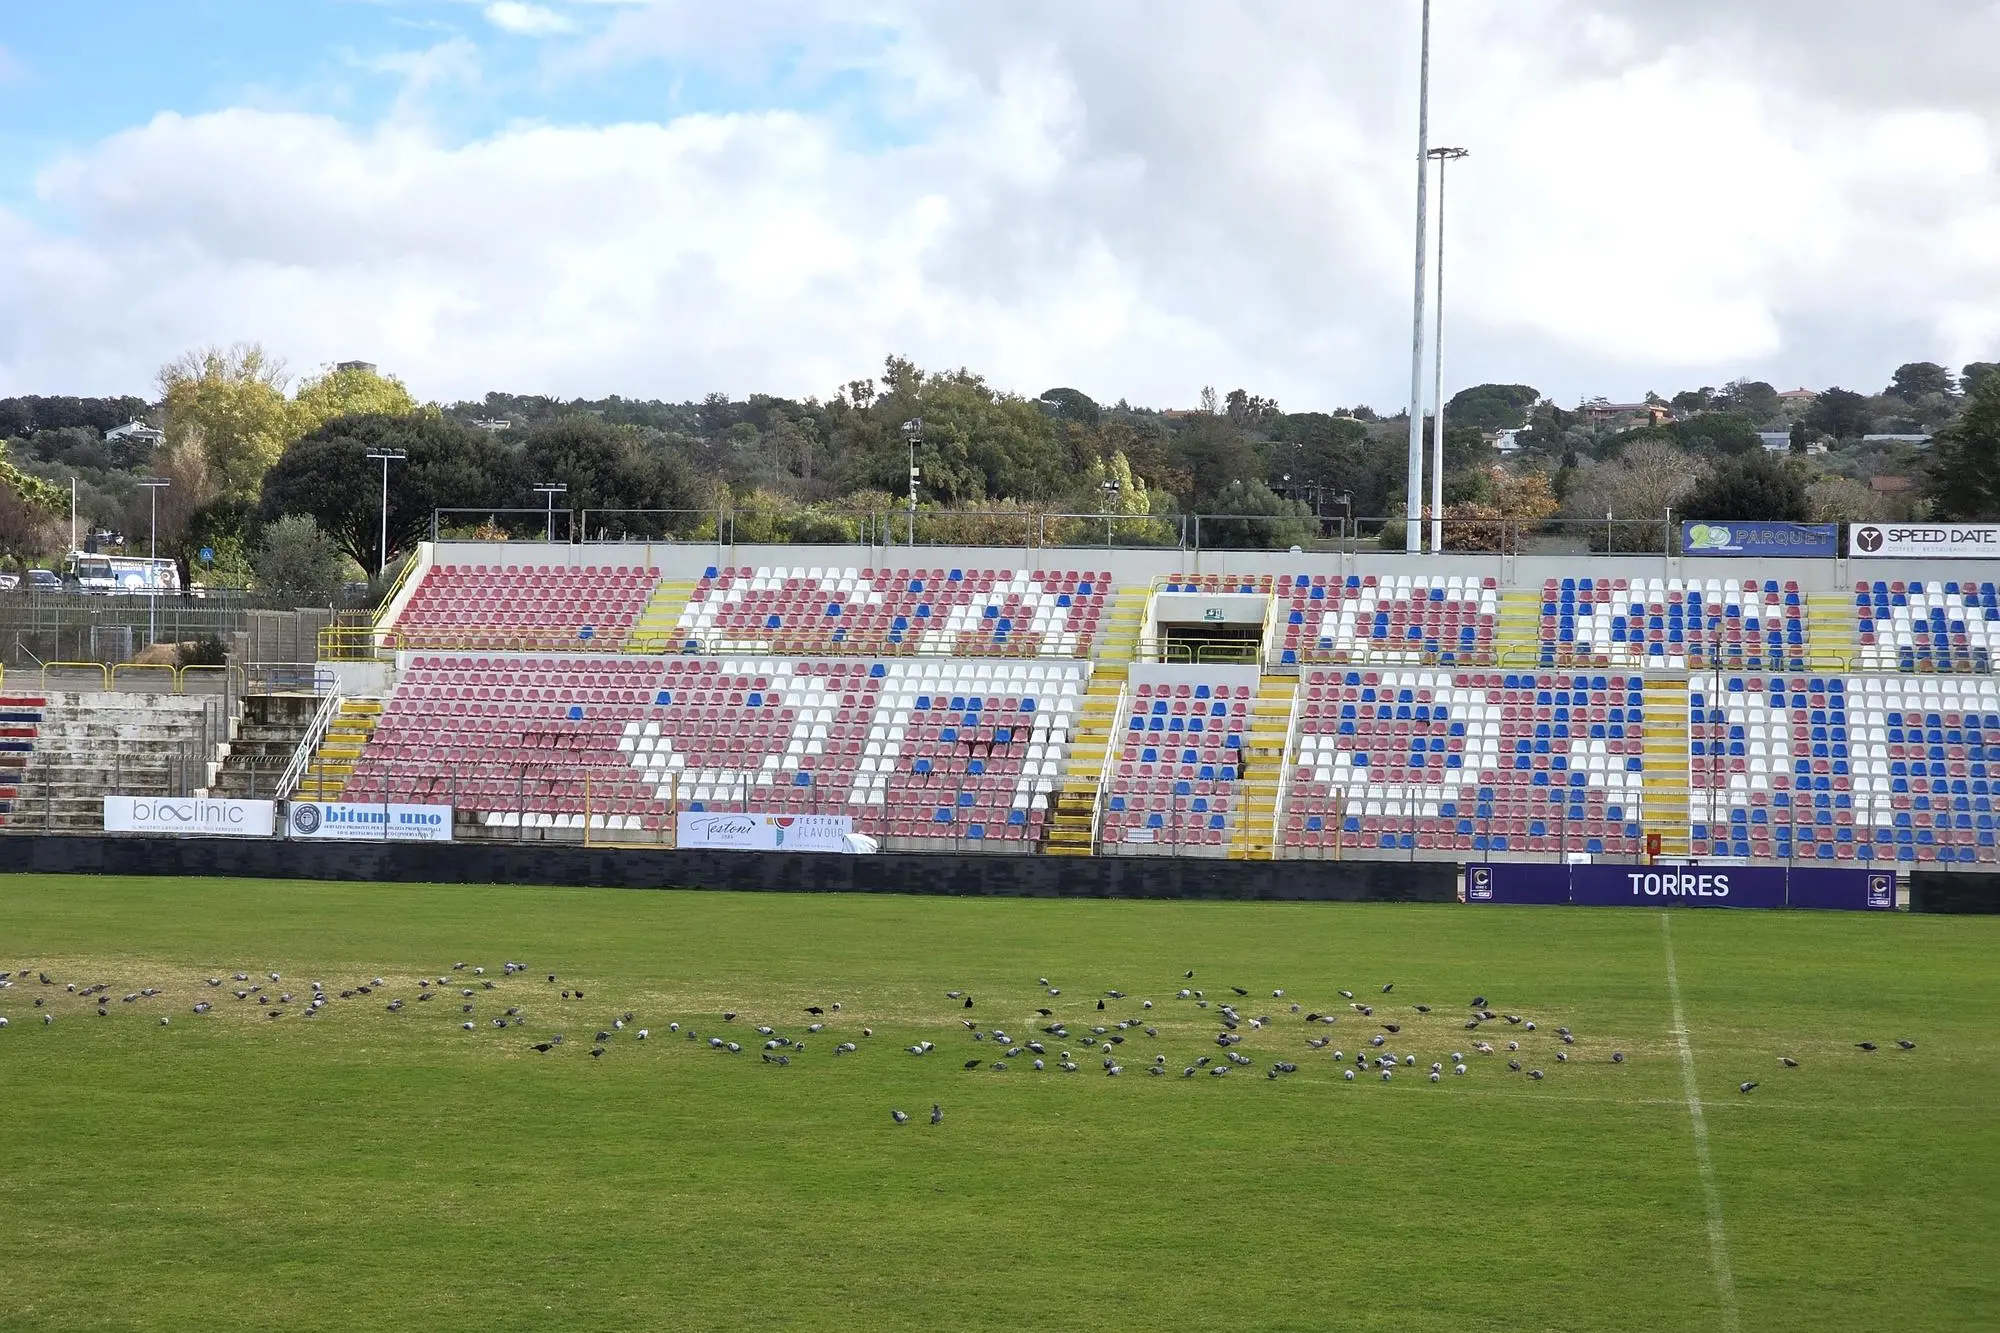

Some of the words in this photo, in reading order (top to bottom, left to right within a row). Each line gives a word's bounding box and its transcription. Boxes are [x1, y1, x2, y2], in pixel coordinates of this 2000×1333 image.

[1735, 529, 1830, 547] PARQUET
[1887, 529, 1947, 543] SPEED
[1951, 529, 1997, 543] DATE
[325, 805, 391, 824] bitum
[400, 812, 442, 825] uno
[799, 817, 844, 825] TESTONI
[690, 815, 755, 840] Testoni
[798, 826, 844, 839] FLAVOUR
[1627, 873, 1729, 897] TORRES
